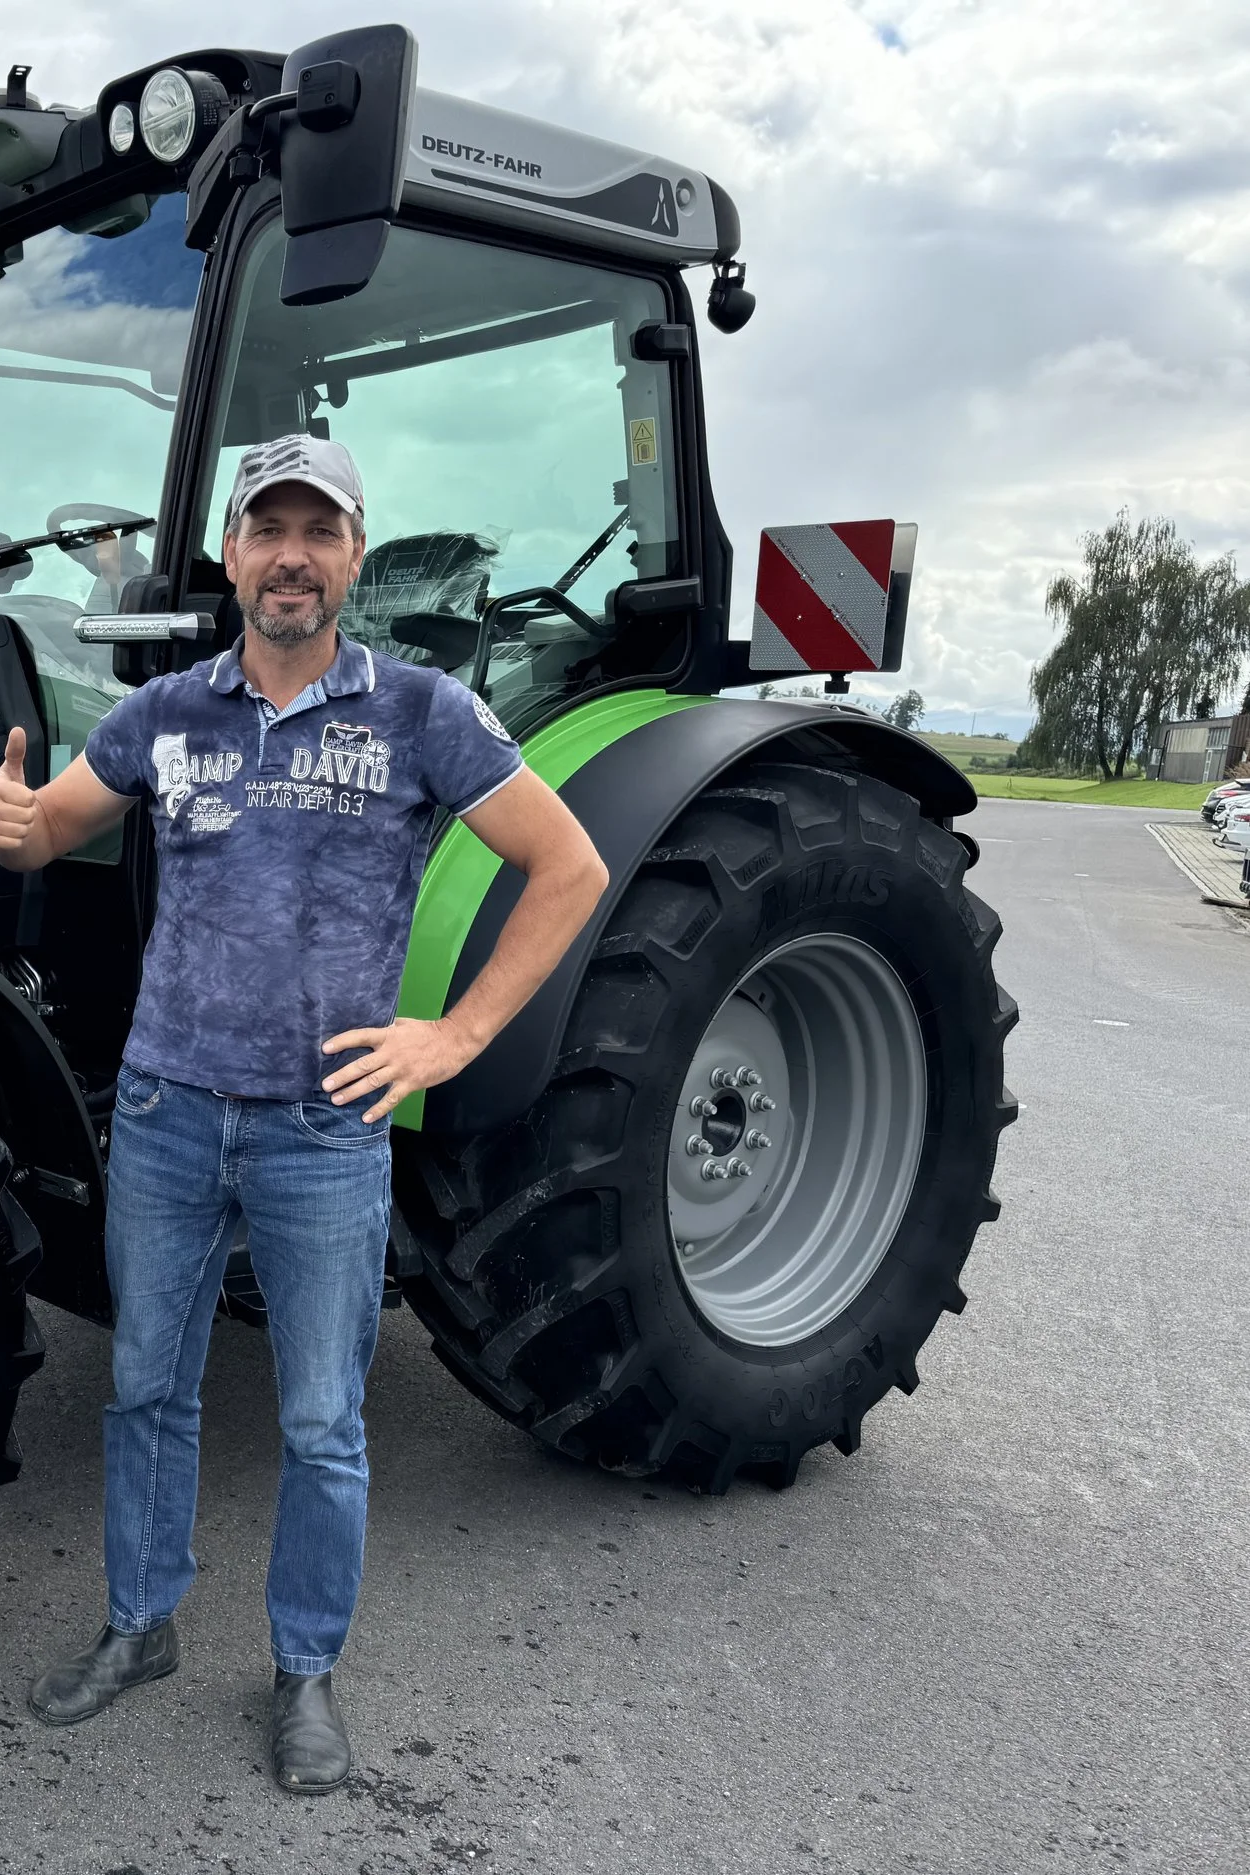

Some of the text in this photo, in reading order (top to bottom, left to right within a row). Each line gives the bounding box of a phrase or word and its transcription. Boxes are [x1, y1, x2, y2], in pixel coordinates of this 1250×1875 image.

[421, 135, 542, 179] DEUTZ-FAHR
[168, 752, 243, 785] CAMP
[290, 748, 390, 793] DAVID
